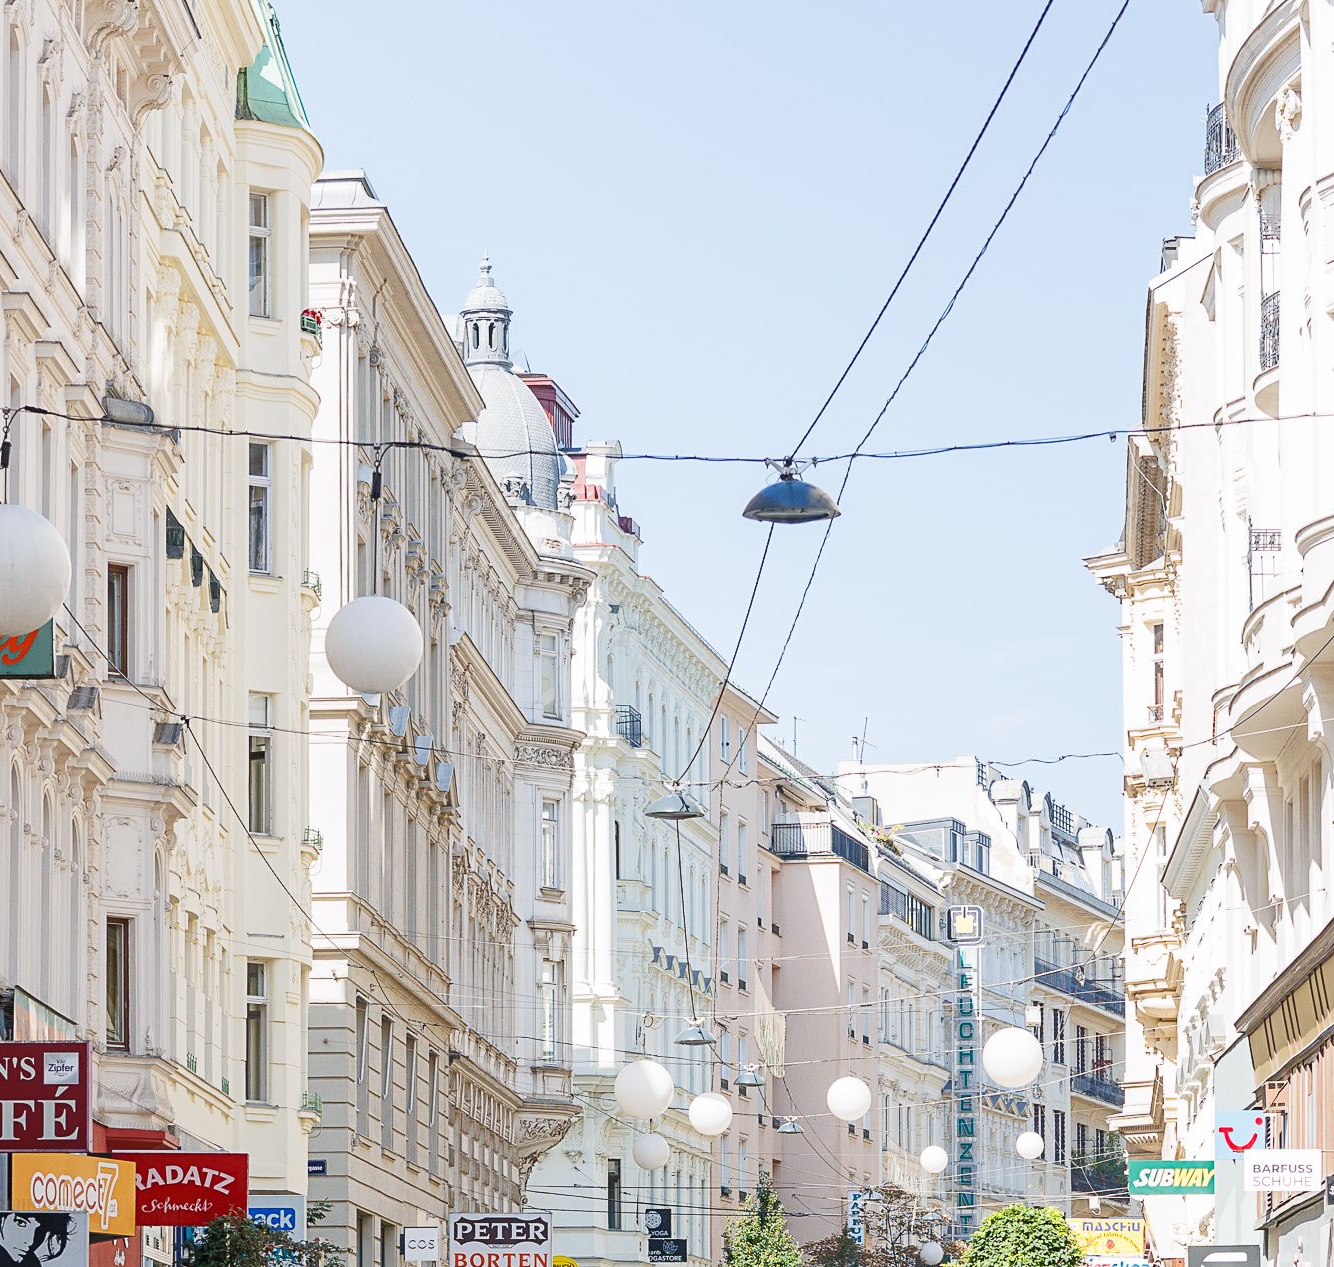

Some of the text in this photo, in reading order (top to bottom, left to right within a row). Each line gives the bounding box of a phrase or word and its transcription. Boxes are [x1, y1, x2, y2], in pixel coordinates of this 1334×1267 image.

[48, 1062, 75, 1075] Zipfer
[1252, 1164, 1314, 1174] BARFUSS
[136, 1165, 236, 1196] RADATZ
[1132, 1168, 1216, 1190] SUBWAY
[1252, 1176, 1313, 1188] SCHUHE
[248, 1209, 293, 1229] ack
[455, 1222, 547, 1241] PETER
[408, 1240, 435, 1250] COS
